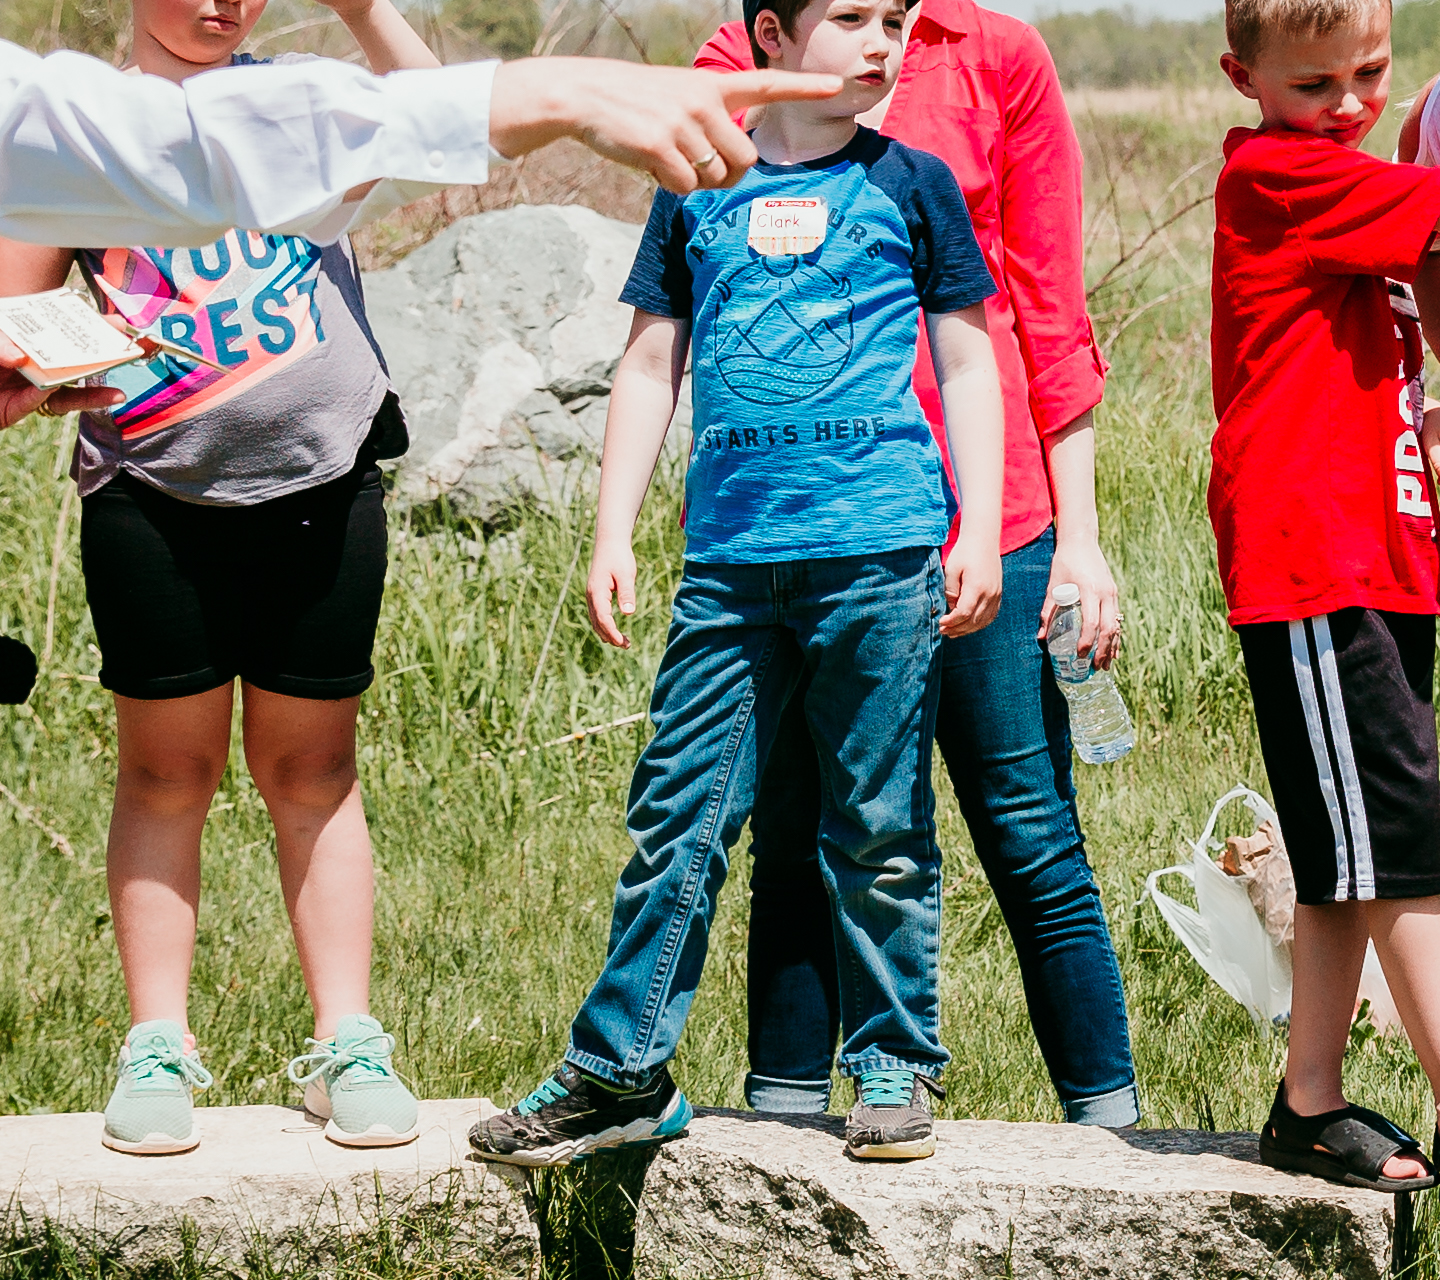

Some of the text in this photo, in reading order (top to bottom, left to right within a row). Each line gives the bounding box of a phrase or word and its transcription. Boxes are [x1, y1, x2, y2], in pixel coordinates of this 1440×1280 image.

[689, 206, 885, 264] ADVURE
[756, 213, 800, 229] Clark
[161, 278, 326, 376] BEST
[703, 416, 887, 450] STARTS HERE
